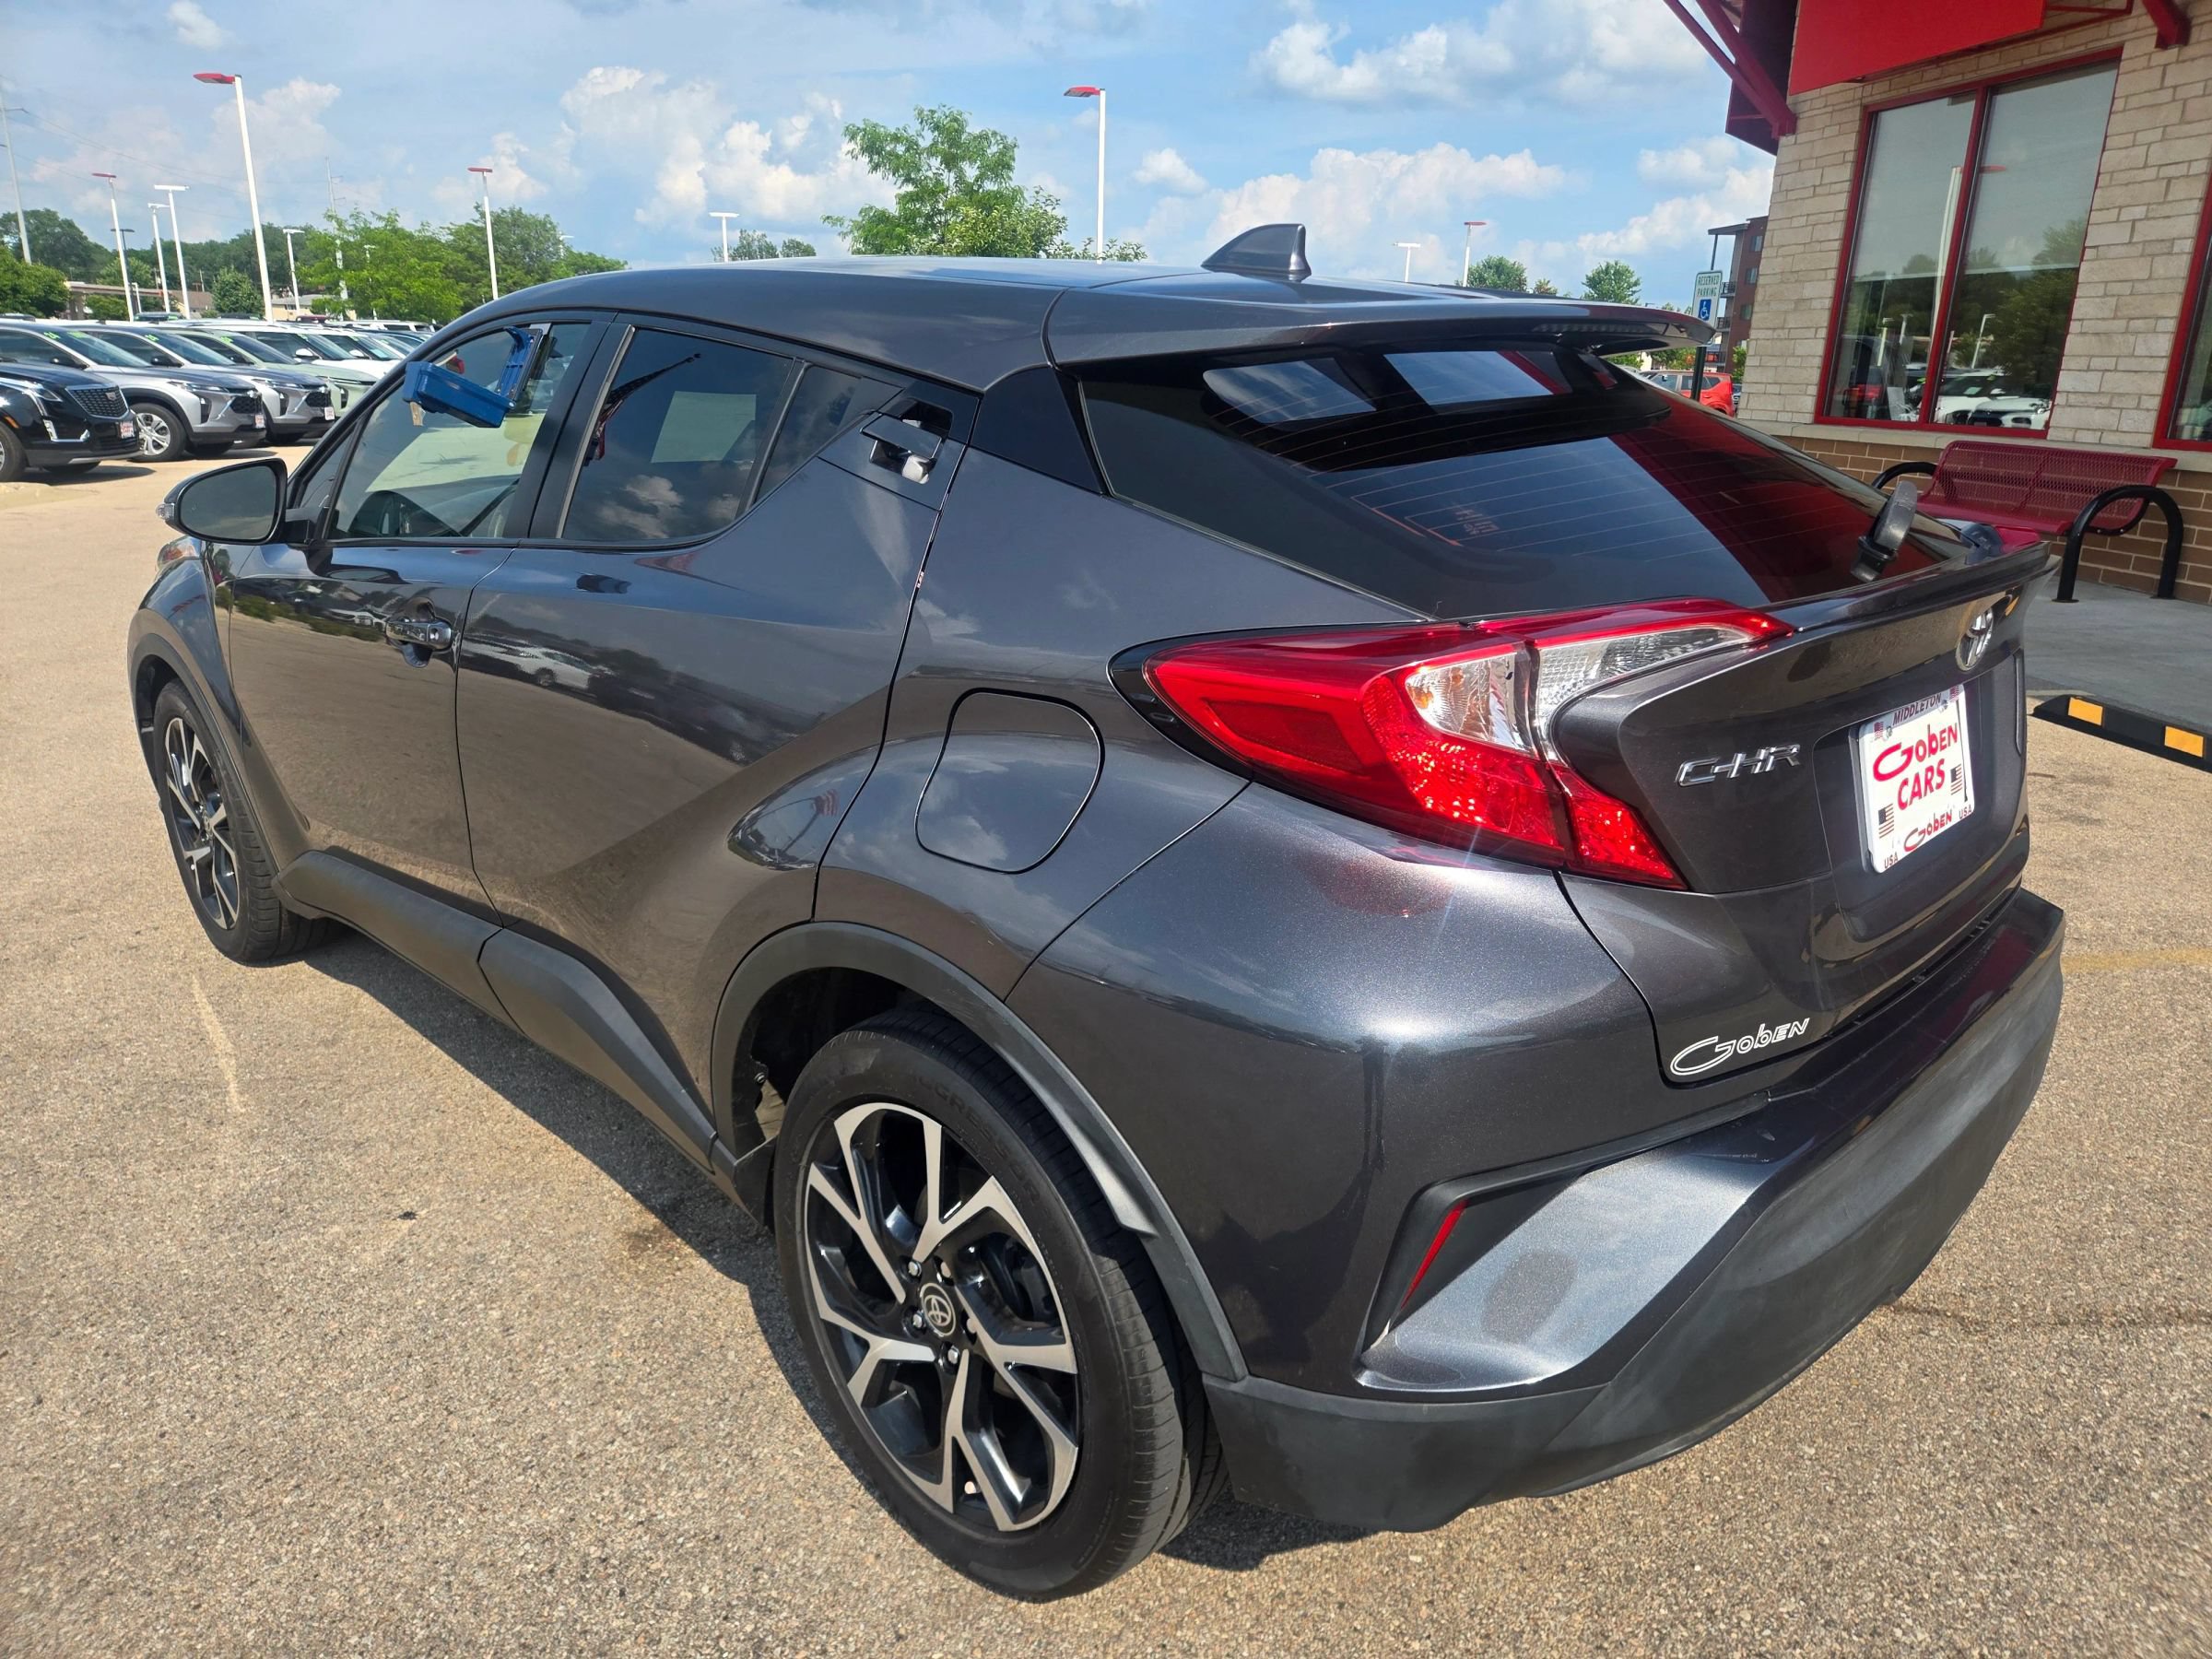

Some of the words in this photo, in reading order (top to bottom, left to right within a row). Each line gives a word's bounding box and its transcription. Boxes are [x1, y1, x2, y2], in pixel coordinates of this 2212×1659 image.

[1698, 275, 1720, 286] RESERVED
[1697, 287, 1718, 297] PARKING
[1892, 693, 1942, 726] MIDDLETON
[1676, 743, 1801, 787] C-HR
[1898, 759, 1946, 810] CARS
[1959, 806, 1972, 819] USA
[1884, 854, 1899, 869] USA
